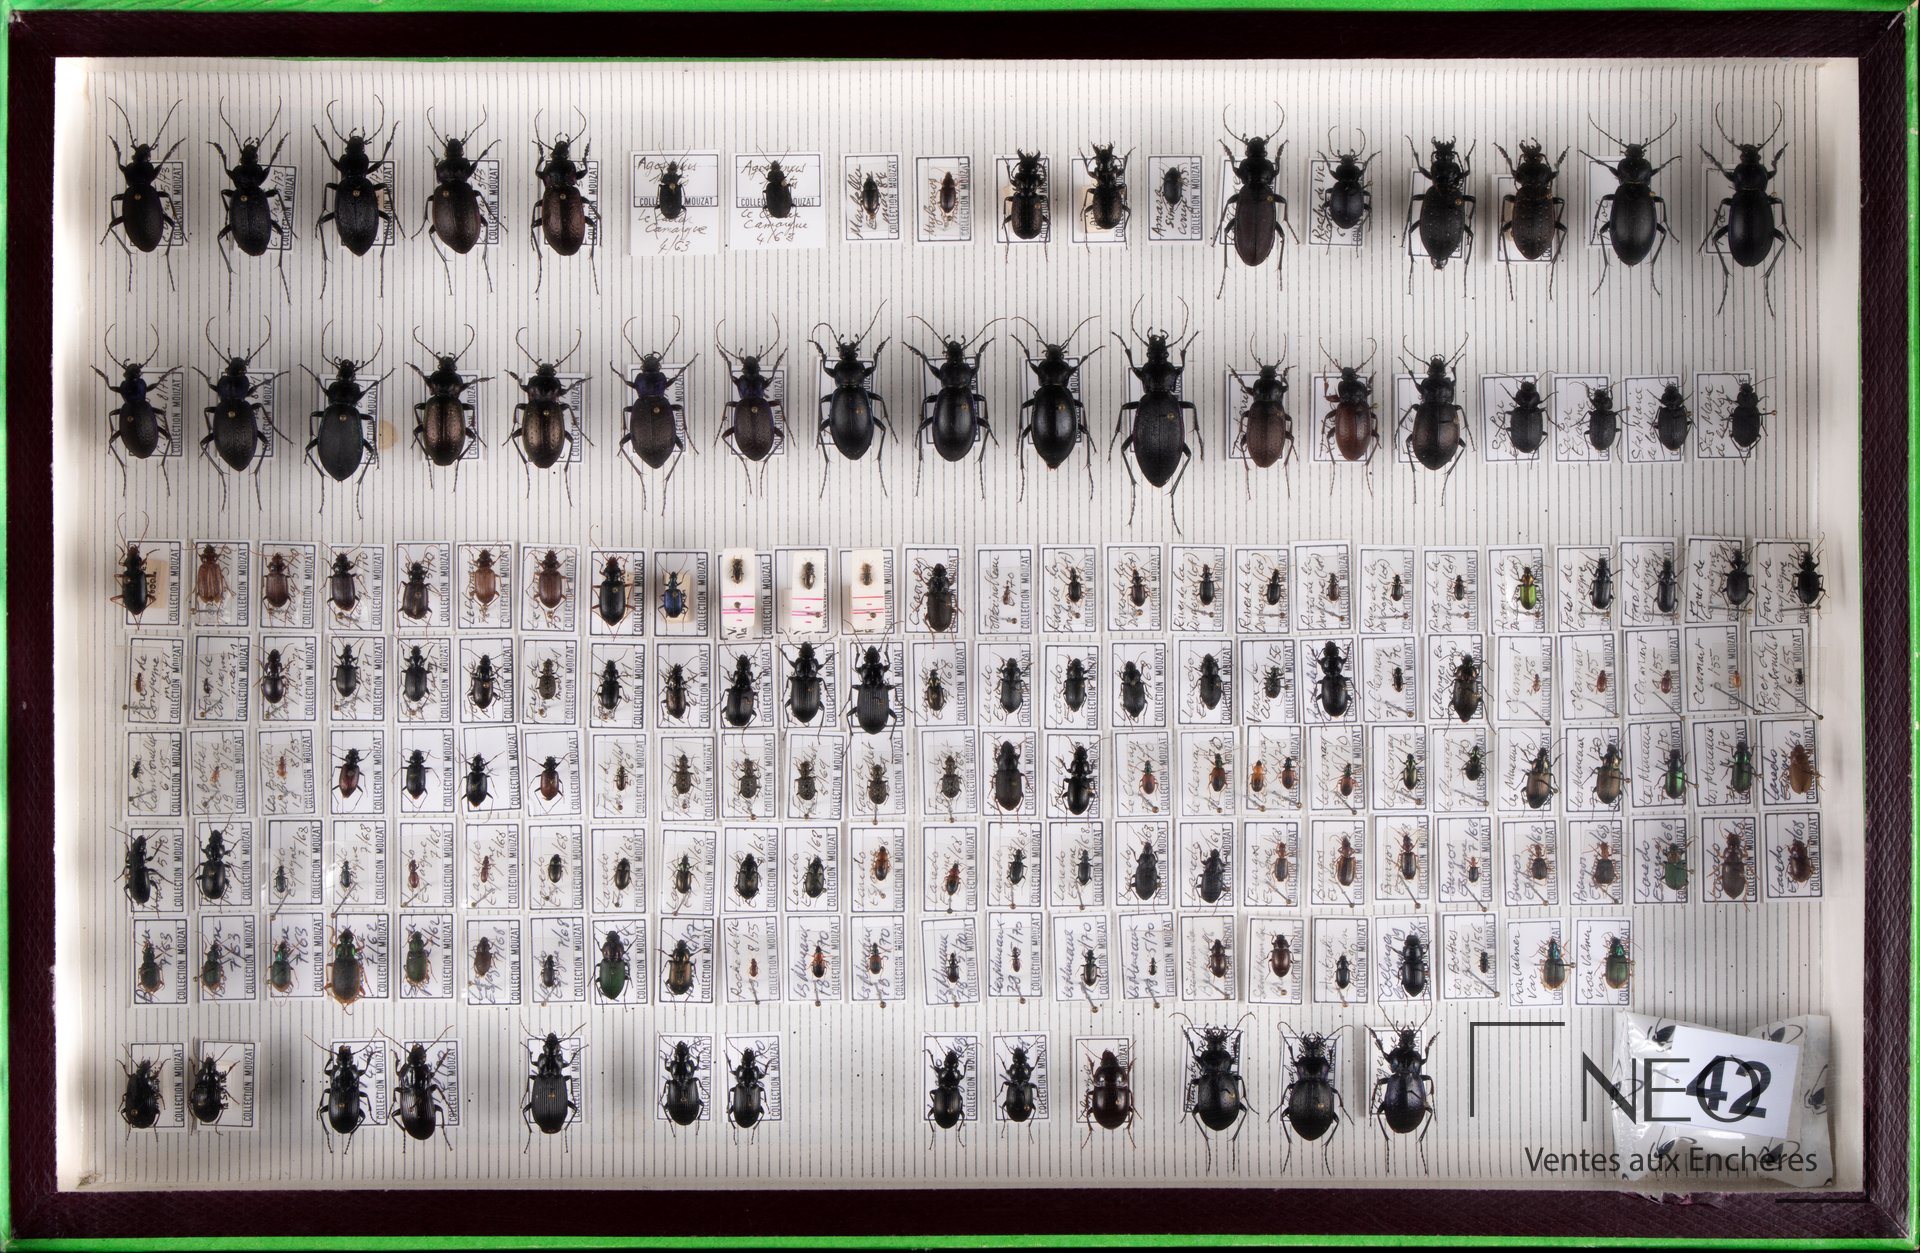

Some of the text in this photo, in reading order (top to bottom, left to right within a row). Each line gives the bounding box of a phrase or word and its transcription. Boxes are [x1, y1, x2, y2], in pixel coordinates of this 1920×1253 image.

[684, 197, 713, 206] MOUZAT
[888, 160, 897, 234] COLLECTION MOUZAT
[1191, 161, 1200, 235] COLLECTION MOUZAT
[172, 379, 181, 453] COLLECTION MOUZAT
[169, 548, 179, 622] COLLECTION MOUZAT
[238, 547, 248, 621] COLLECTION MOUZAT
[371, 552, 382, 626] COLLECTION MOUZAT
[697, 558, 706, 631] COLLECTION MOUZAT
[1021, 556, 1030, 629] COLLECTION MOUZAT
[1085, 554, 1094, 628] COLLECTION MOUZAT
[236, 644, 248, 718] COLLECTION MOUZAT
[305, 642, 314, 716] COLLECTION MOUZAT
[373, 642, 383, 716] COLLECTION MOUZAT
[565, 645, 575, 719] COLLECTION MOUZAT
[1604, 639, 1613, 667] MOUZAT
[1727, 631, 1736, 659] MOUZAT
[1793, 634, 1803, 662] MOUZAT
[700, 649, 708, 723] COLLECTION MOUZAT
[956, 648, 966, 721] COLLECTION MOUZAT
[1155, 648, 1164, 722] COLLECTION MOUZAT
[302, 735, 313, 809] COLLECTION MOUZAT
[374, 737, 382, 810] COLLECTION MOUZAT
[444, 733, 452, 807] COLLECTION MOUZAT
[507, 732, 519, 806] COLLECTION MOUZAT
[765, 739, 773, 812] COLLECTION MOUZAT
[1158, 737, 1168, 811] COLLECTION MOUZAT
[312, 825, 320, 899] COLLECTION MOUZAT
[376, 826, 384, 900] COLLECTION MOUZAT
[508, 830, 517, 904] COLLECTION MOUZAT
[966, 832, 975, 906] COLLECTION MOUZAT
[1480, 824, 1490, 898] COLLECTION MOUZAT
[1809, 818, 1818, 846] MOUZAT
[703, 838, 714, 911] COLLECTION MOUZAT
[767, 834, 776, 908] COLLECTION MOUZAT
[827, 833, 836, 907] COLLECTION MOUZAT
[177, 927, 185, 1000] COLLECTION MOUZAT
[244, 920, 254, 994] COLLECTION MOUZAT
[378, 919, 387, 993] COLLECTION MOUZAT
[443, 921, 451, 994] COLLECTION MOUZAT
[573, 923, 583, 997] COLLECTION MOUZAT
[702, 926, 713, 999] COLLECTION MOUZAT
[1357, 924, 1367, 998] COLLECTION MOUZAT
[1526, 969, 1539, 999] Var
[174, 1049, 182, 1122] COLLECTION MOUZAT
[242, 1048, 253, 1122] COLLECTION MOUZAT
[1686, 1055, 1772, 1119] 42
